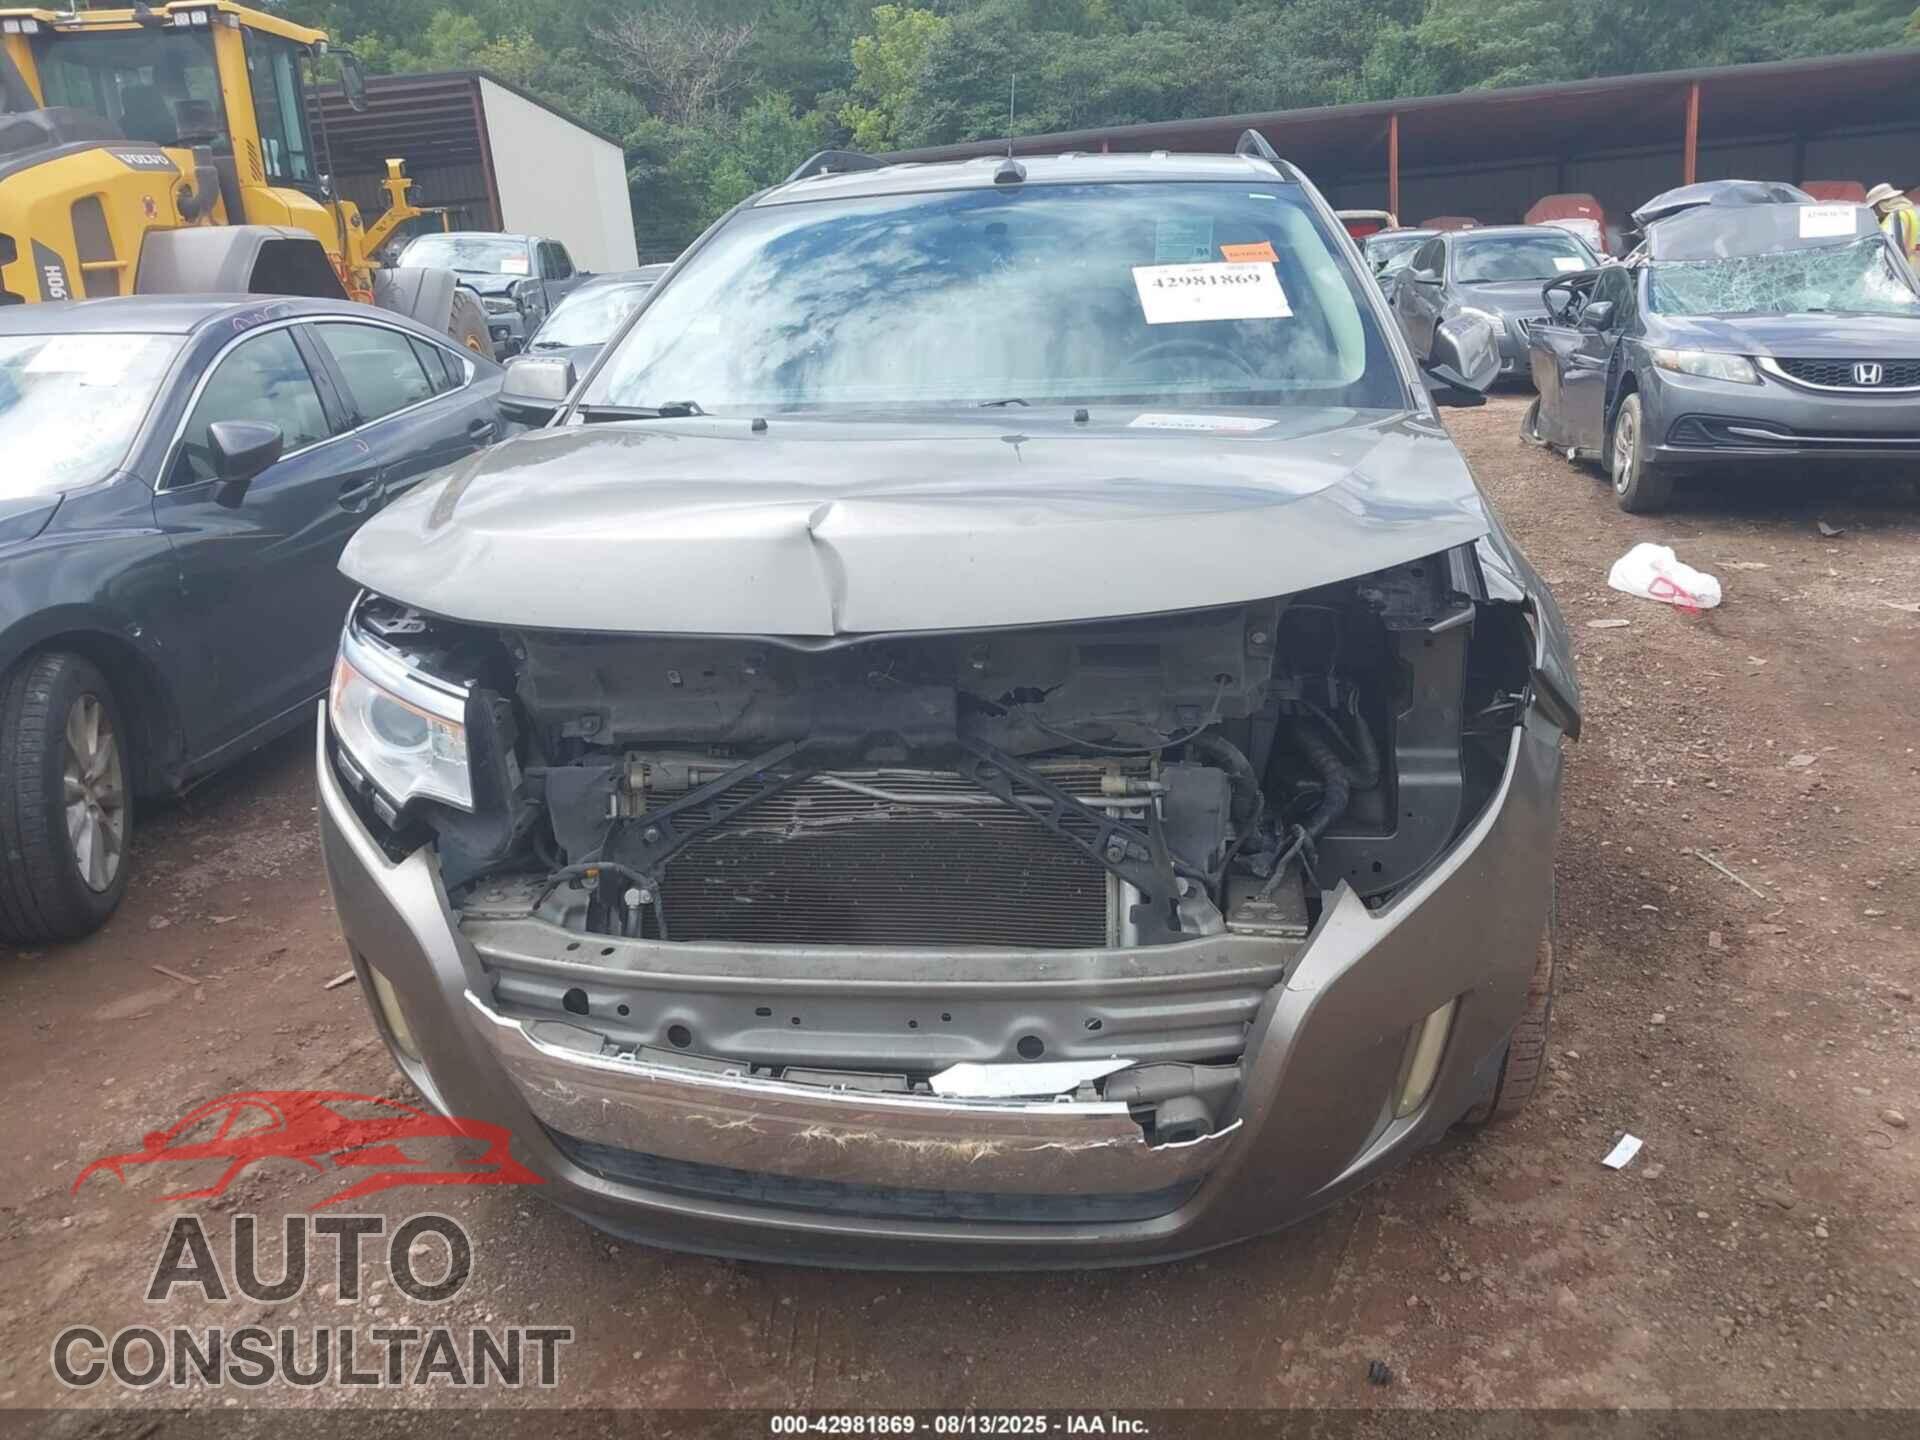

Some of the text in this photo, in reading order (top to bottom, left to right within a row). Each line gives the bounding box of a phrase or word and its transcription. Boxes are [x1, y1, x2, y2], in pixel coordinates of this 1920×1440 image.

[119, 153, 169, 166] VOLVO
[44, 265, 69, 301] 90H
[1152, 273, 1262, 289] 42981869
